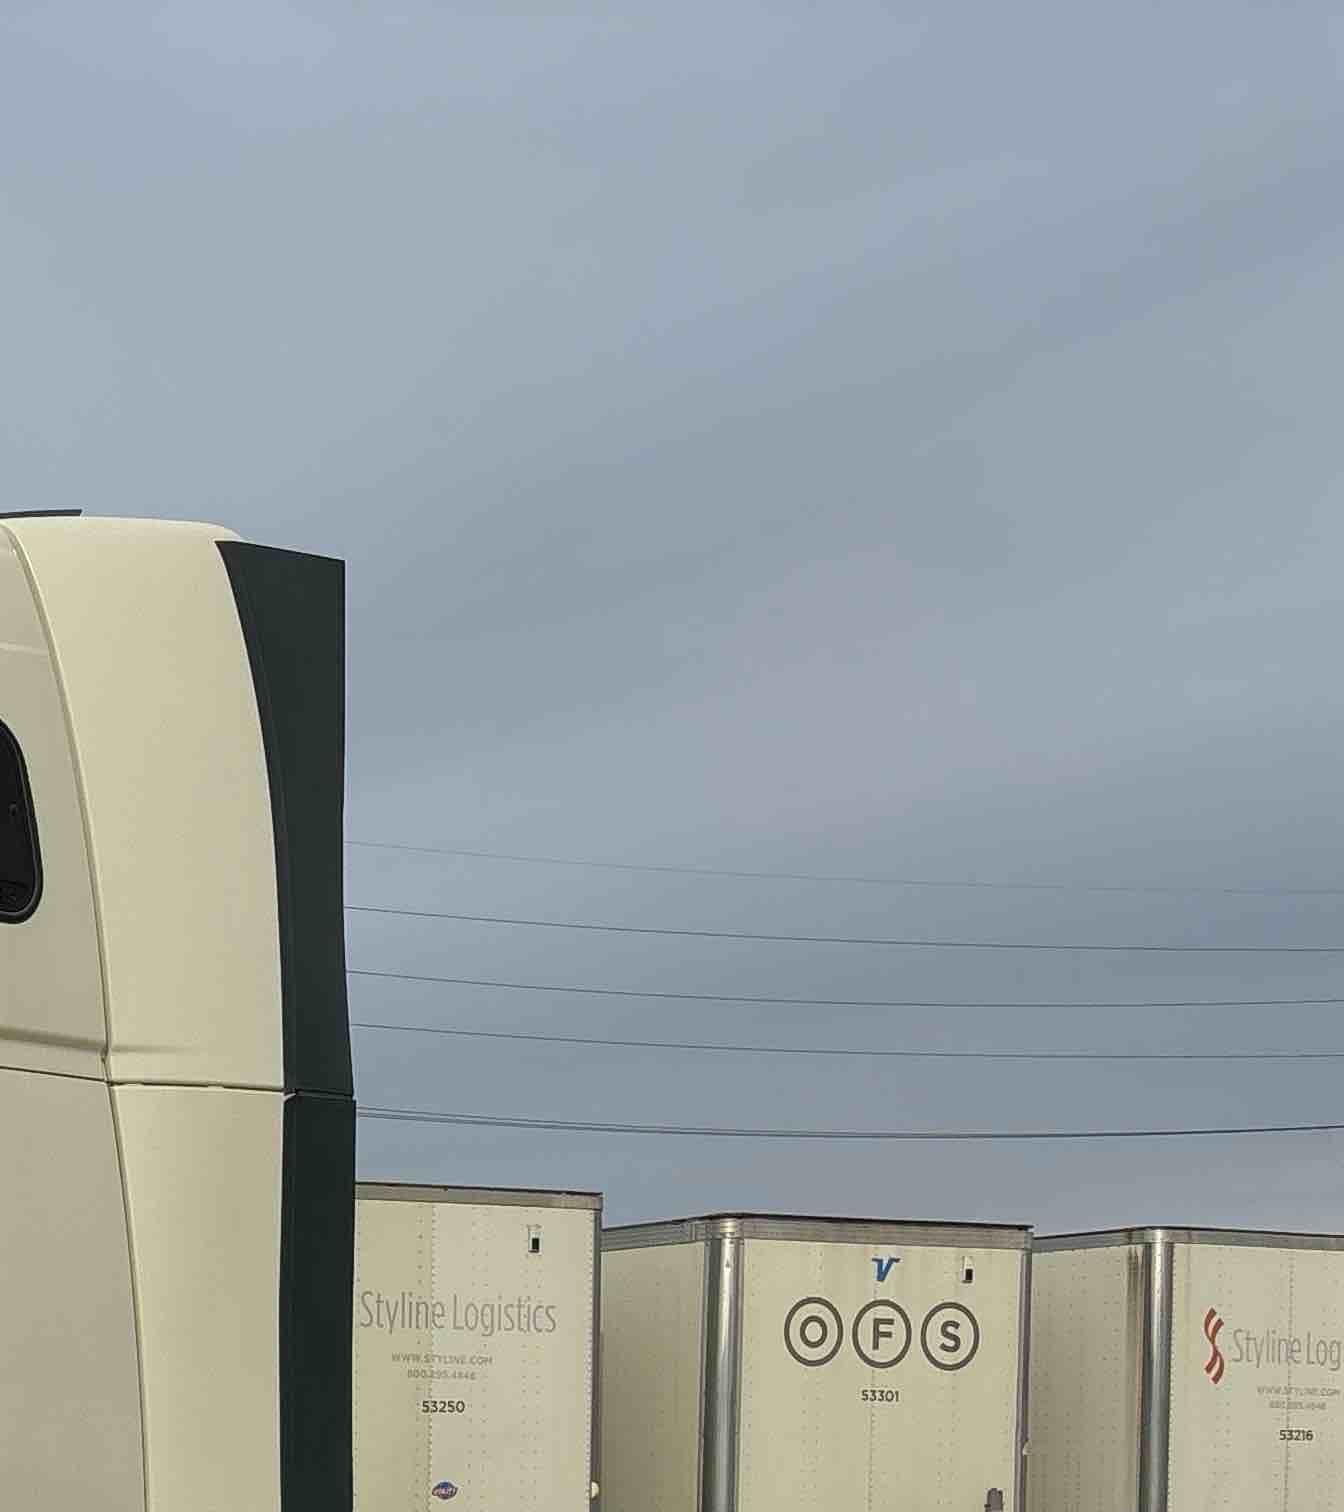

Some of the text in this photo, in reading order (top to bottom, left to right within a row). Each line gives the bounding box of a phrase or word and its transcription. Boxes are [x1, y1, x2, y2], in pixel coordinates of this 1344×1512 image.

[360, 1290, 557, 1336] Styline Logistics
[1232, 1329, 1301, 1368] Styline
[860, 1388, 900, 1403] 53301
[421, 1400, 465, 1413] 53250
[1279, 1429, 1313, 1441] 53216
